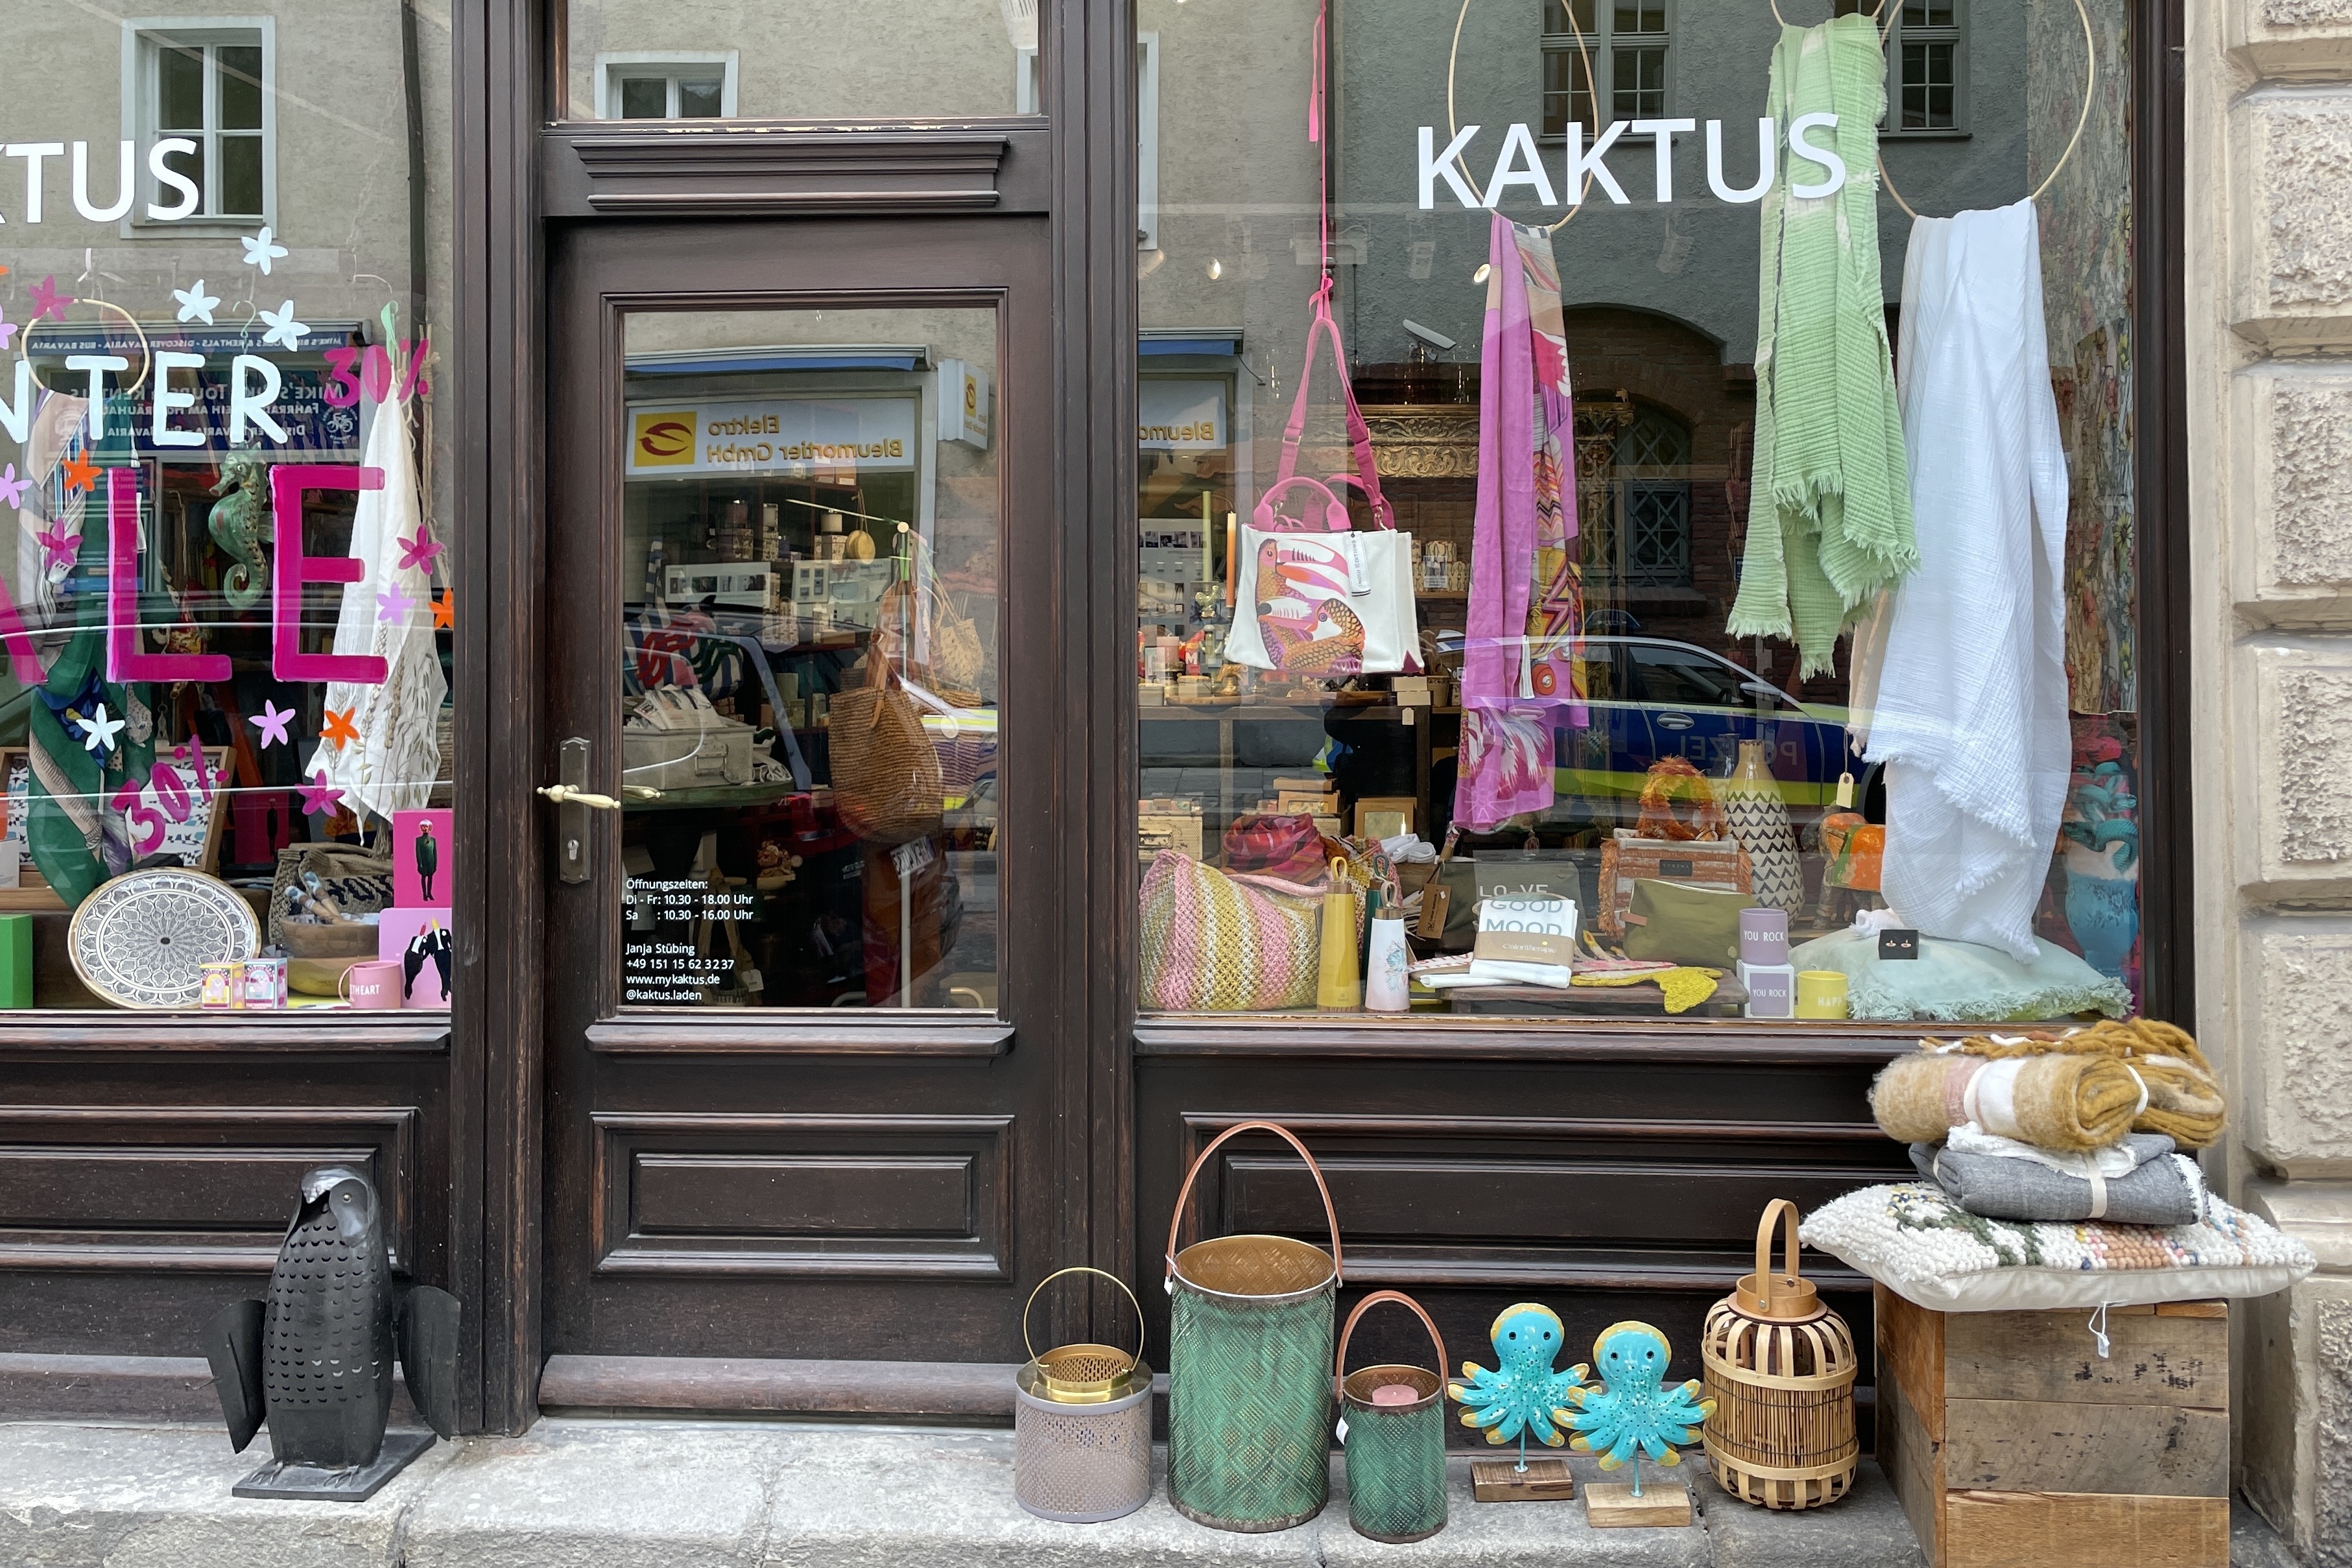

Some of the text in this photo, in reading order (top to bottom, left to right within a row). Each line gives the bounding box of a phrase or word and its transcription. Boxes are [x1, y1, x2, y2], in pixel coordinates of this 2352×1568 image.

[1418, 112, 1847, 210] KAKTUS
[0, 137, 200, 224] TUS
[324, 337, 429, 409] 30%
[626, 877, 708, 892] Öffnungszeiten:
[626, 894, 637, 905] Di
[647, 895, 661, 905] Fr:
[664, 894, 691, 905] 10.30
[702, 894, 730, 905] 18.00
[733, 894, 754, 905] Uhr
[1490, 899, 1563, 913] GOOD
[626, 910, 639, 920] Sa
[664, 910, 691, 920] 10.30
[702, 910, 730, 920] 16.00
[733, 909, 754, 920] Uhr
[1486, 918, 1563, 936] MOOD
[1744, 930, 1785, 942] YOU ROCK
[625, 942, 695, 956] Janja Stübing
[626, 958, 647, 969] +49
[650, 958, 668, 969] 151
[672, 958, 685, 969] 15
[688, 958, 702, 969] 62
[626, 989, 702, 1001] @kaktus.laden
[1752, 988, 1787, 997] YOU ROCK
